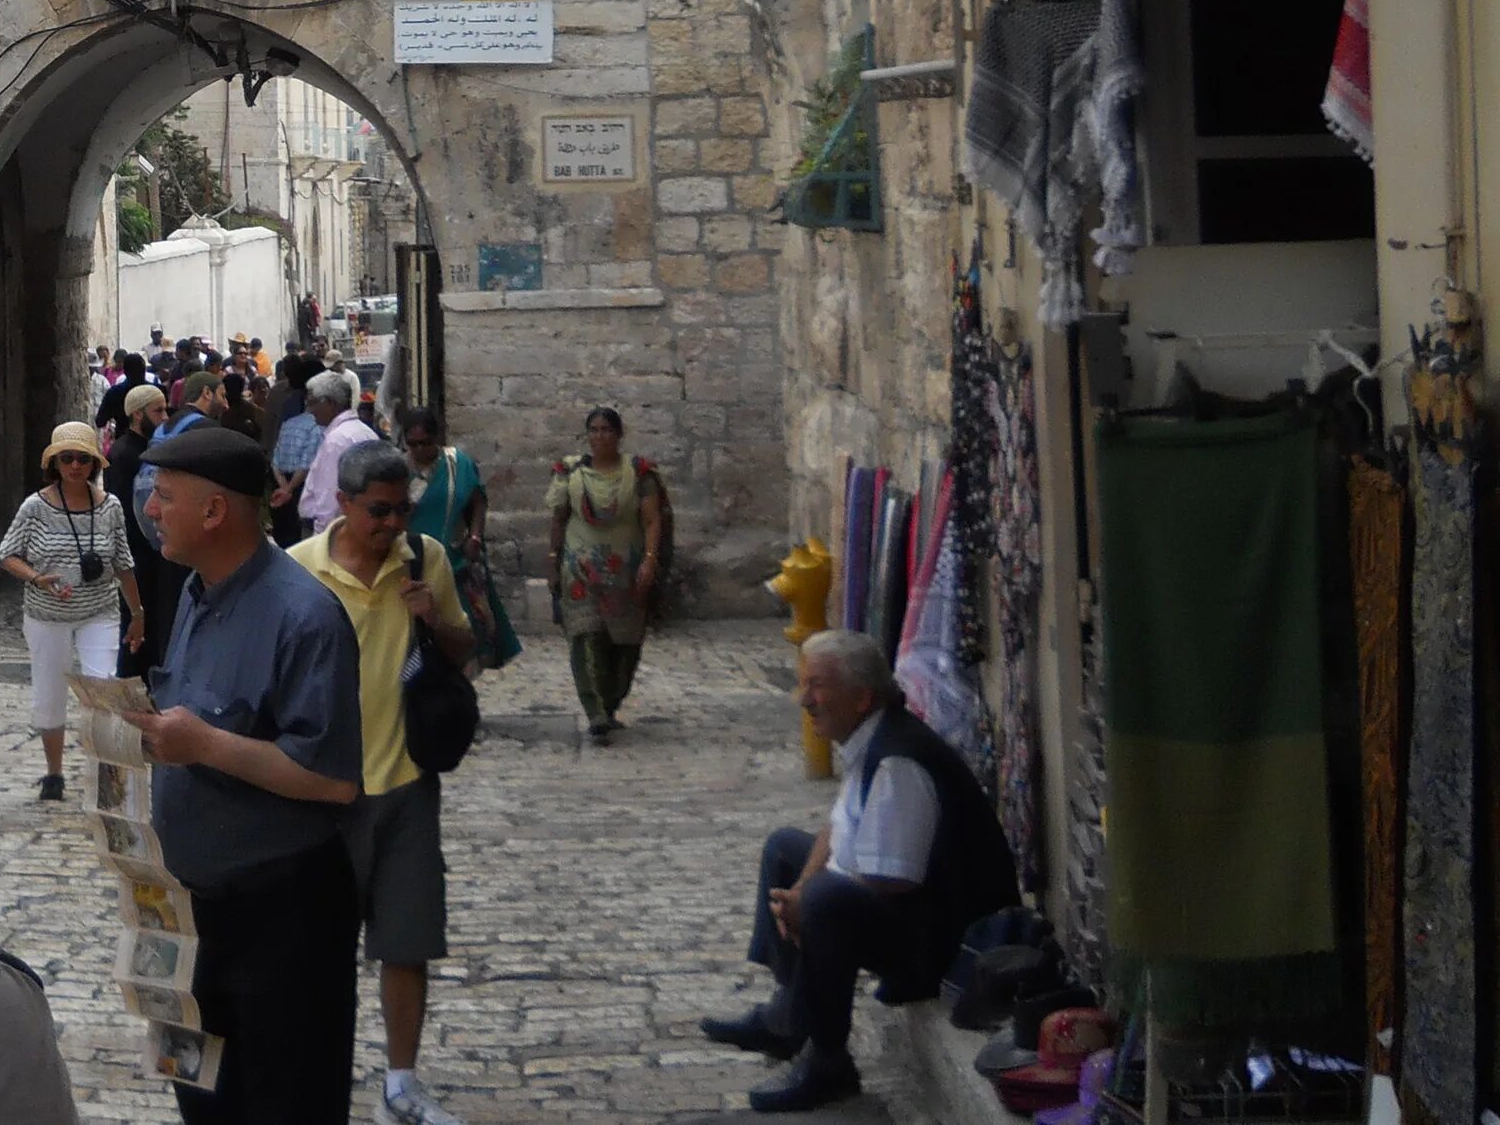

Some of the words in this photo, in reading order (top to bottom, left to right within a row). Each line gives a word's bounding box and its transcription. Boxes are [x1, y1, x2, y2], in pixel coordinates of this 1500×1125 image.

[579, 141, 596, 156] باب
[554, 165, 572, 177] BAB
[578, 164, 606, 176] HUTTA
